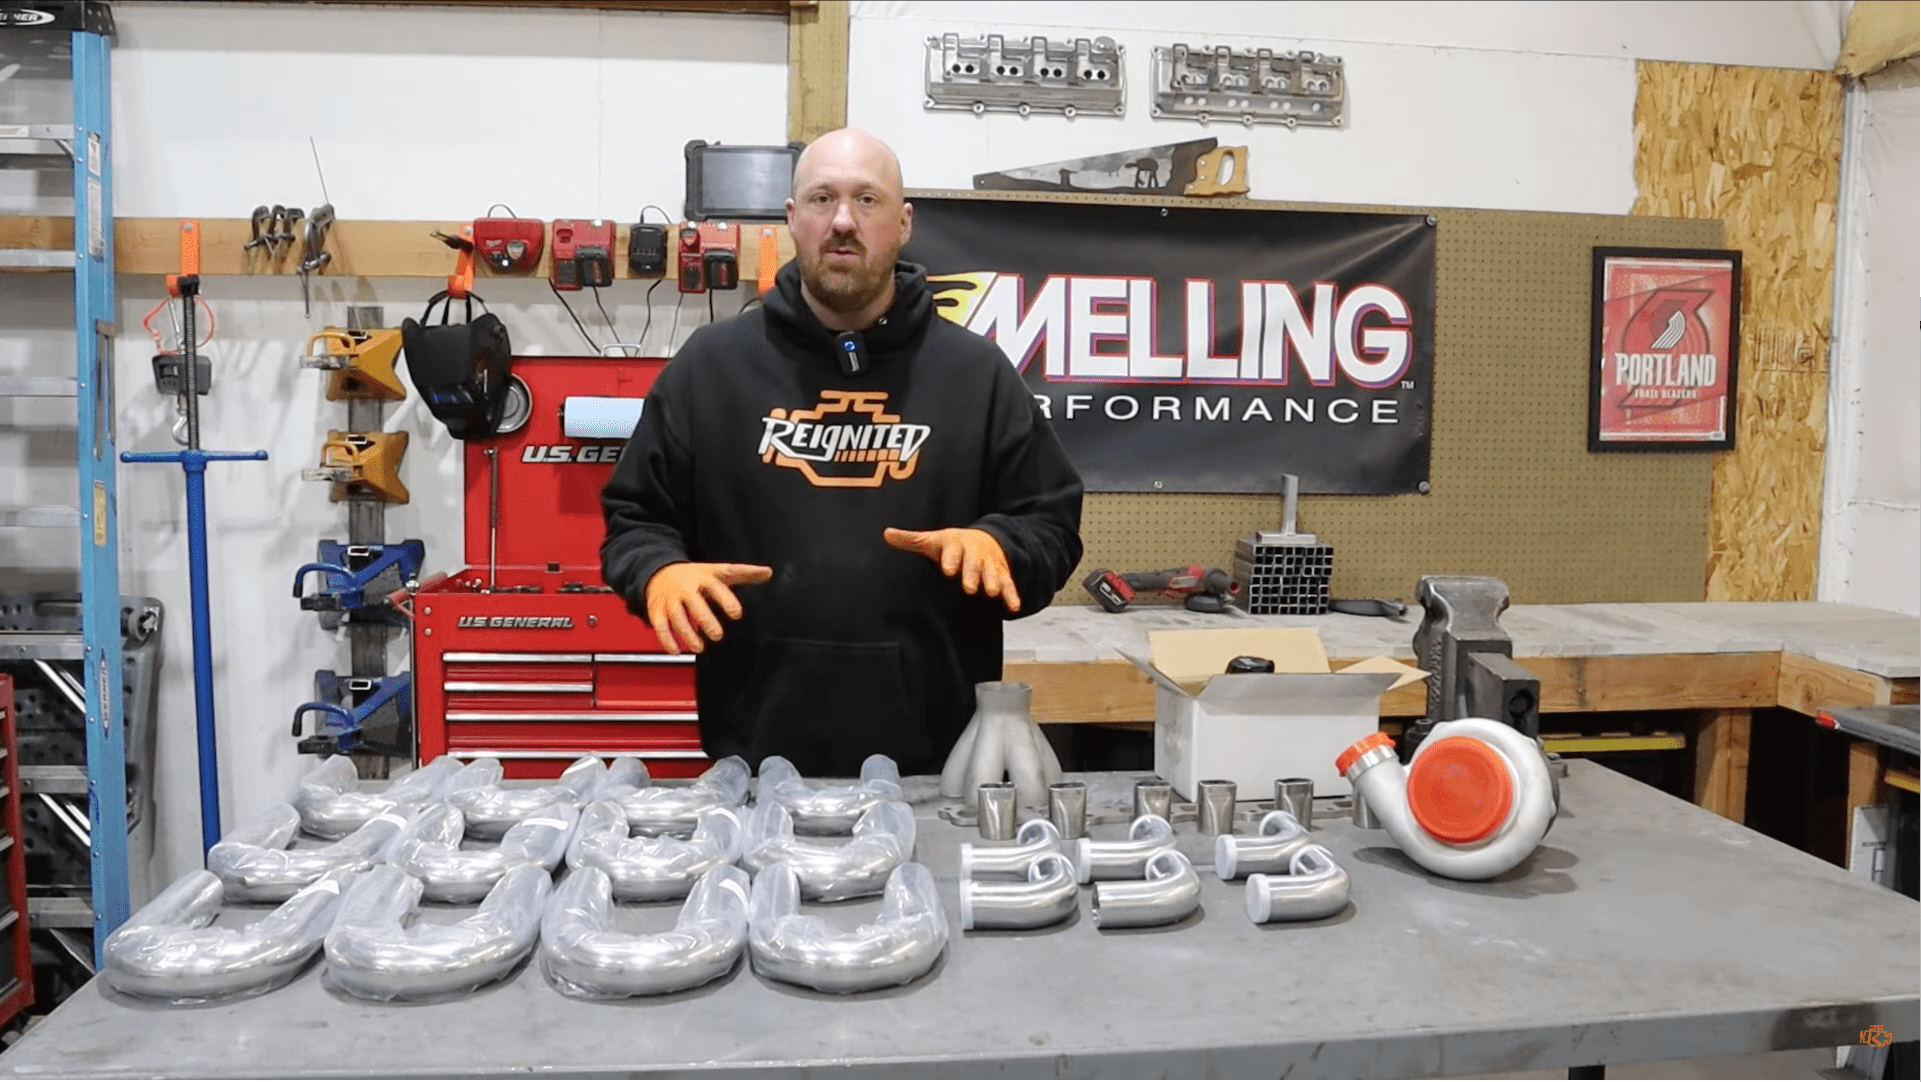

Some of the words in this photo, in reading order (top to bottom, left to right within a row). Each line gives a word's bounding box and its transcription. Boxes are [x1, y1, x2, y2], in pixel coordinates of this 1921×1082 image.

[965, 272, 1412, 387] MELLING
[1615, 352, 1717, 386] PORTLAND
[1033, 394, 1399, 424] RFORMANCE
[1635, 389, 1659, 399] TRAIL
[576, 446, 621, 462] GE
[758, 417, 931, 462] REIGNITED
[489, 616, 574, 628] GENERAL
